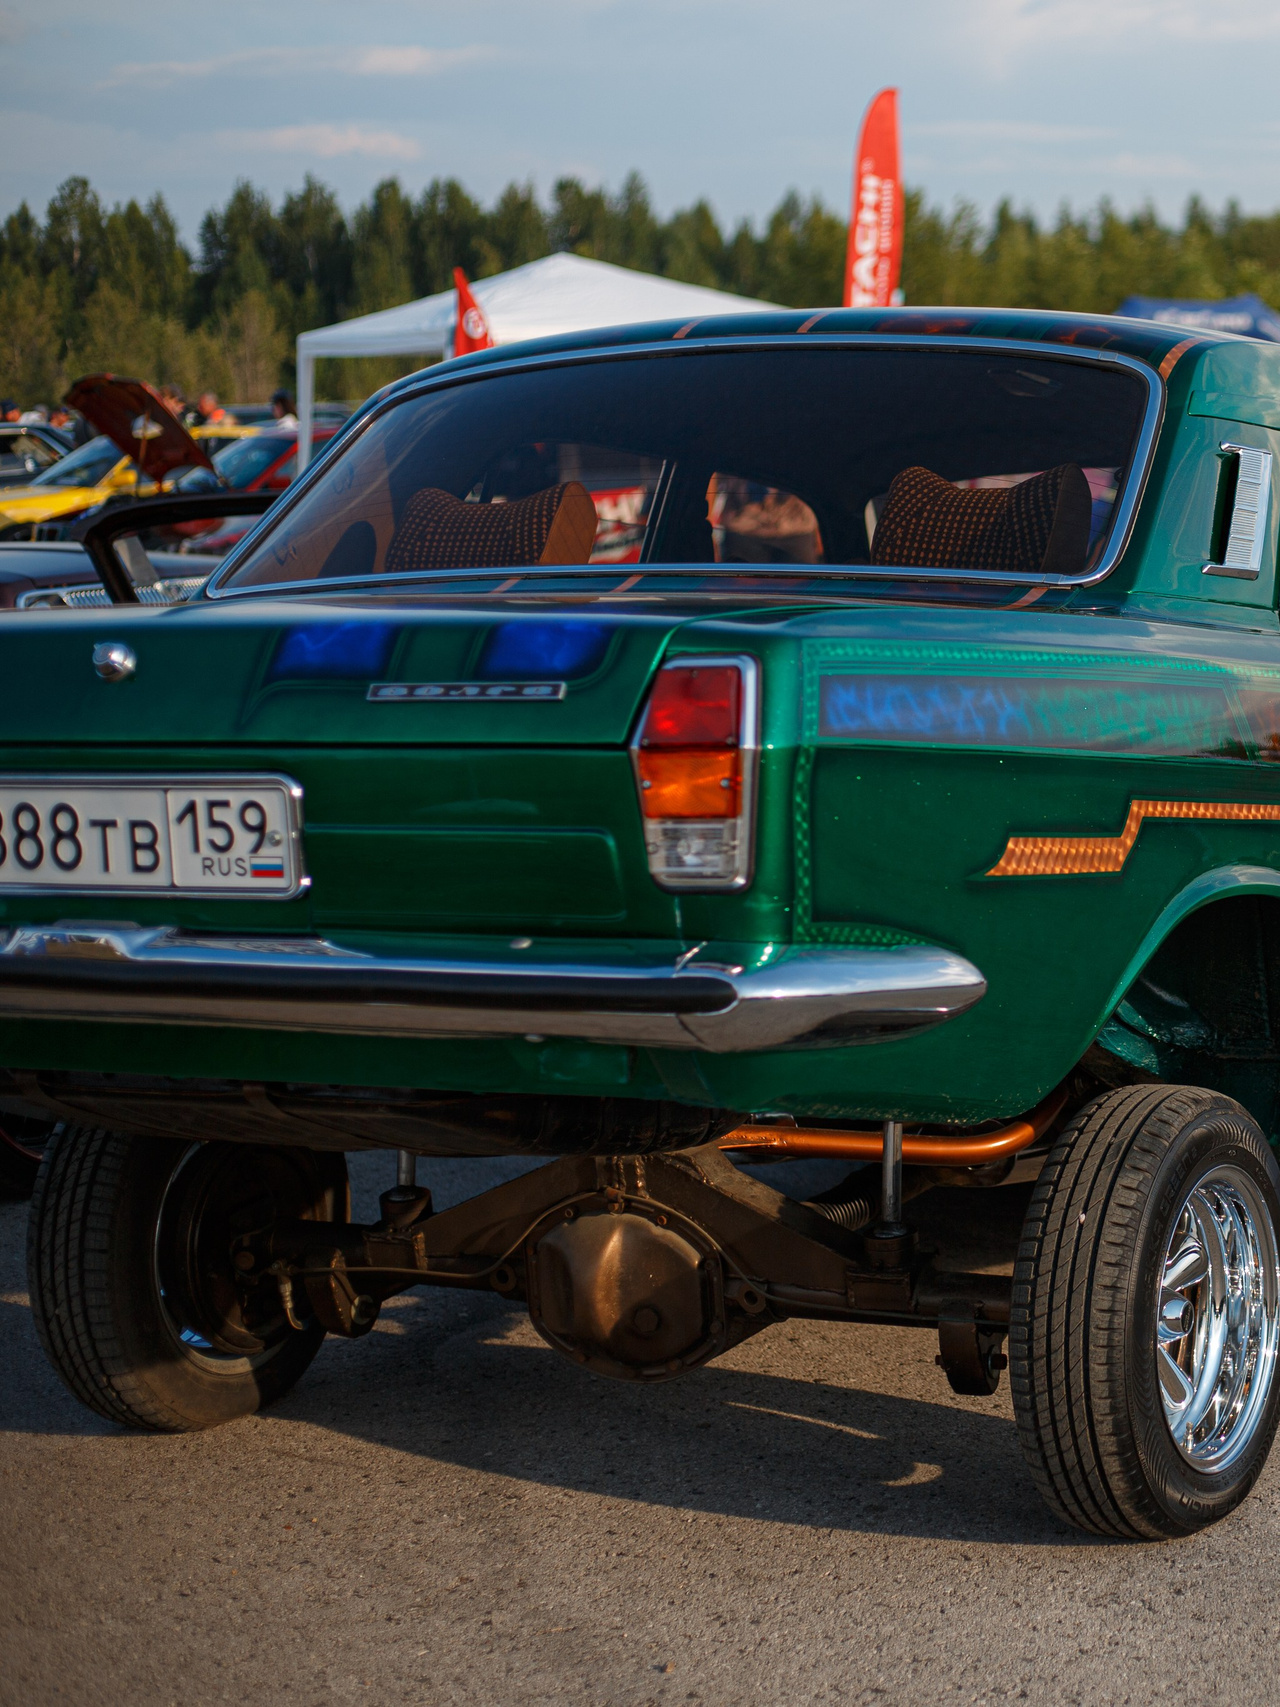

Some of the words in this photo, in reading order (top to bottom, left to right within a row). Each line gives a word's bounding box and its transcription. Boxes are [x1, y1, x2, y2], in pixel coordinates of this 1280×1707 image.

[0, 802, 160, 873] 88ТВ
[175, 800, 267, 854] 159
[202, 857, 247, 877] RUS
